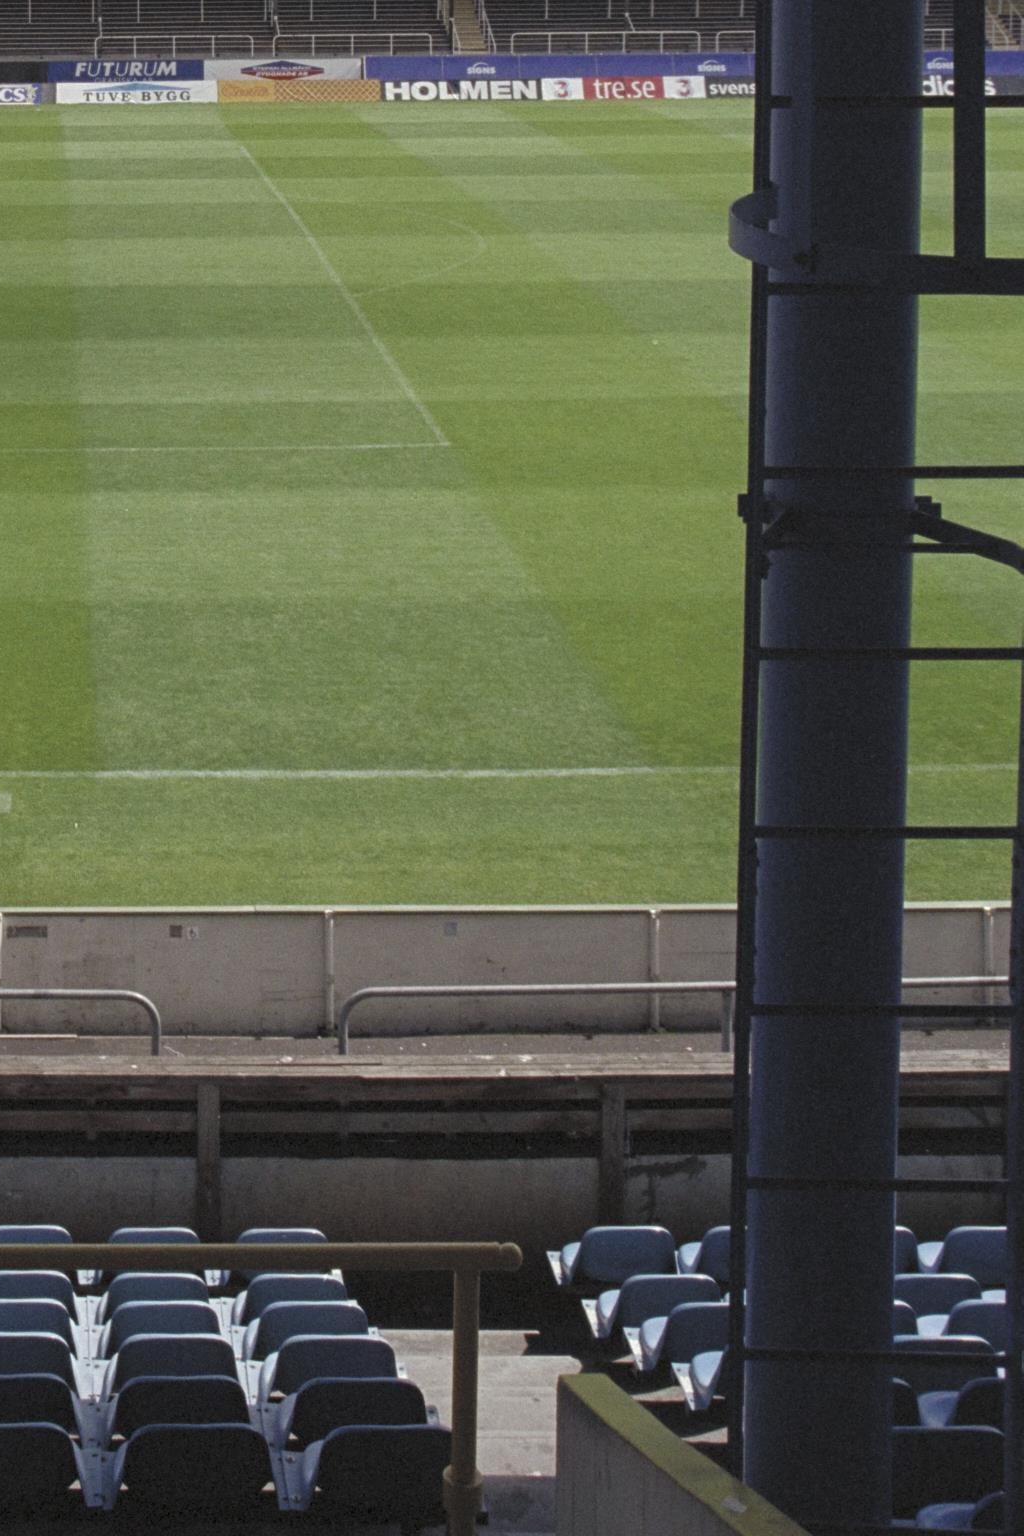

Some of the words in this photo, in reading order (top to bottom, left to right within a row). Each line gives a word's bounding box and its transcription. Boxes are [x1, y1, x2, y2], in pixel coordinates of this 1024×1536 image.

[75, 61, 177, 77] FUTURUM
[83, 92, 131, 101] TUVE
[141, 91, 191, 101] BYGG
[384, 81, 537, 101] HOLMEN
[593, 79, 656, 98] tre.se
